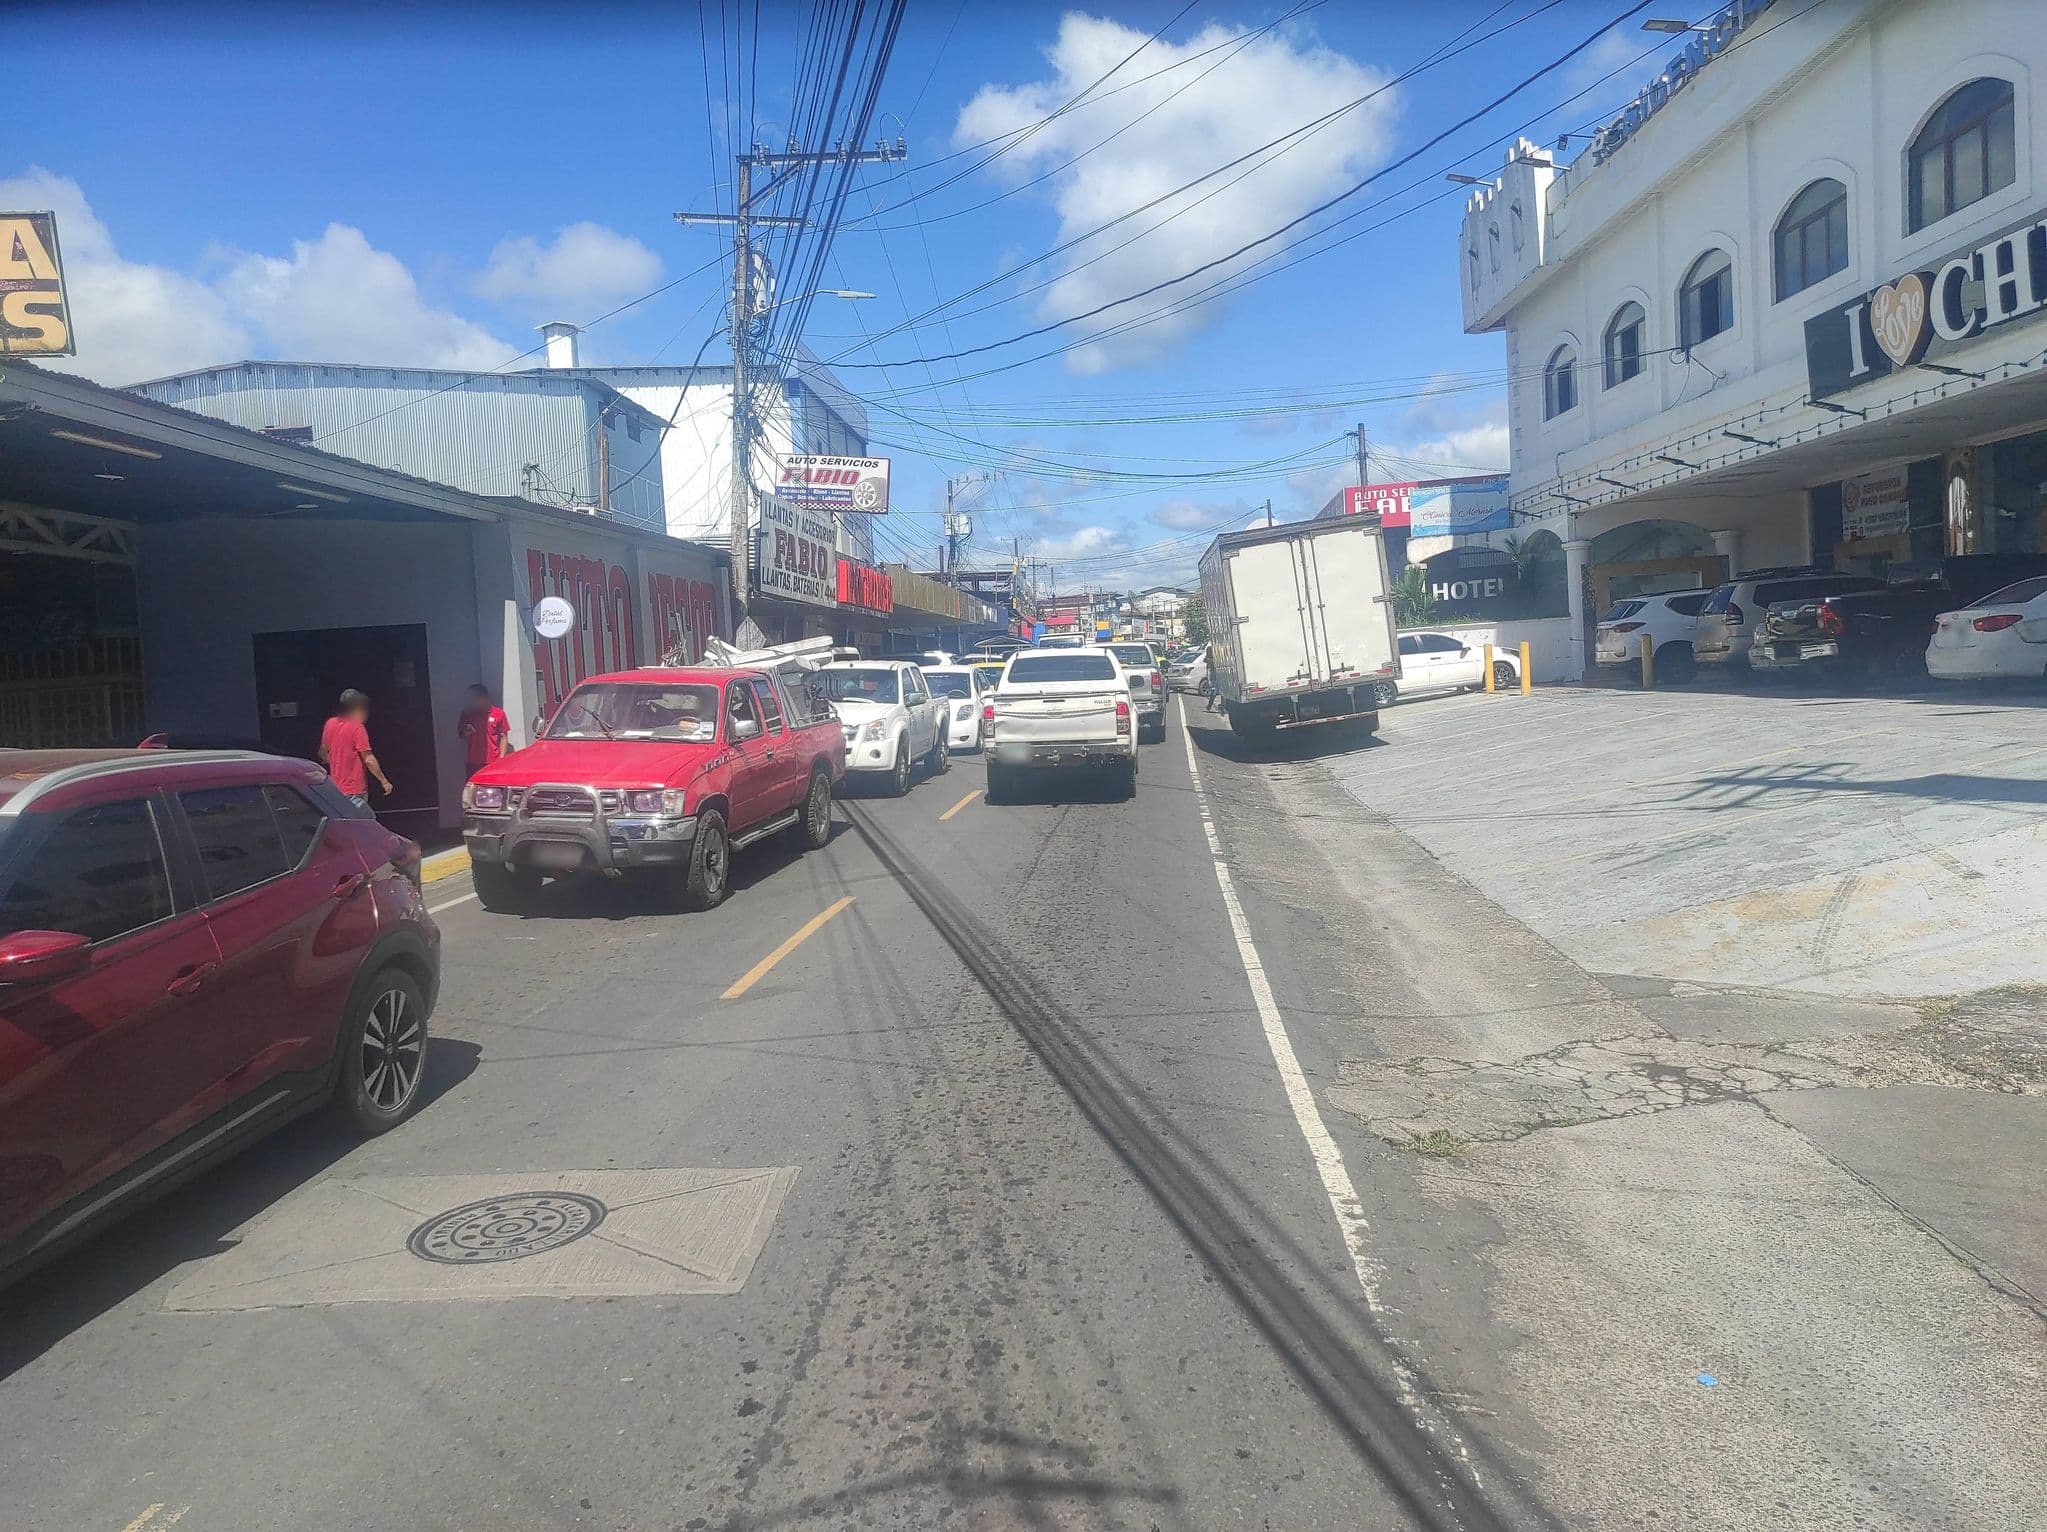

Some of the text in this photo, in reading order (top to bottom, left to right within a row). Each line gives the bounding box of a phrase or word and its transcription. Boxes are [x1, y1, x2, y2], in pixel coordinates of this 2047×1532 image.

[1844, 303, 1869, 377] I
[1930, 217, 2047, 341] CH
[787, 457, 880, 468] AUTO SERVICIOS
[781, 467, 861, 486] FABIO
[1355, 489, 1387, 500] AUTO
[765, 499, 793, 527] LLANTAS
[774, 528, 828, 580] FABIO
